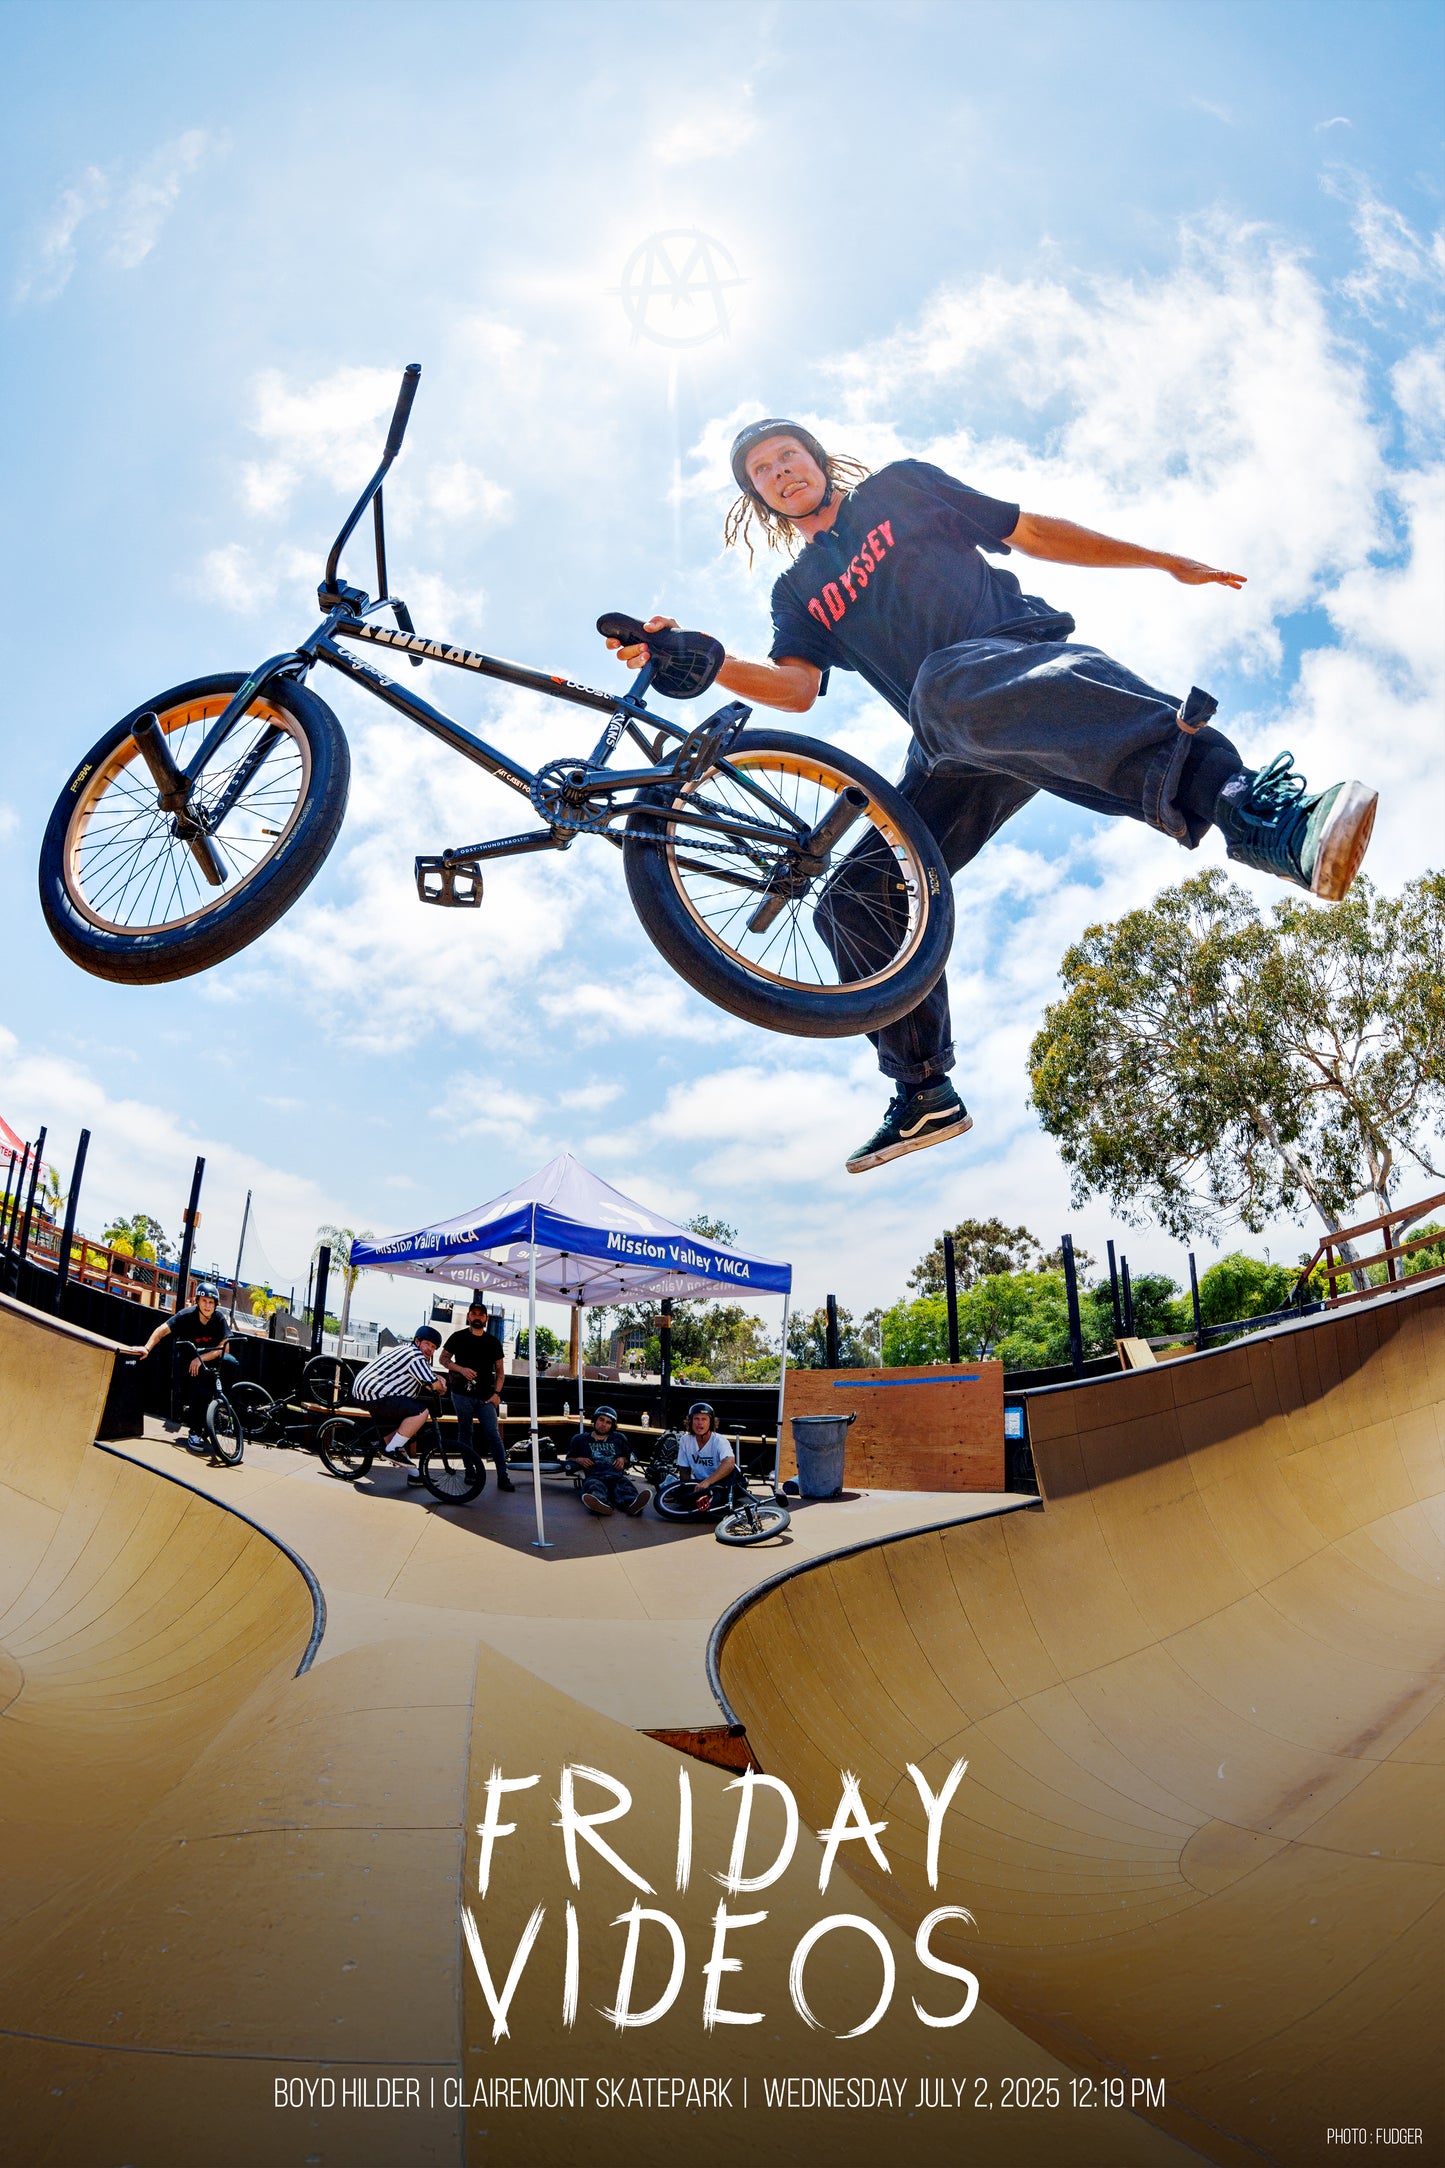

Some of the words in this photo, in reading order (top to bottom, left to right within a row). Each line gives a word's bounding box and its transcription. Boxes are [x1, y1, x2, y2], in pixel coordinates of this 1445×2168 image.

[414, 1233, 442, 1251] Valley
[443, 1229, 480, 1246] YMCA
[606, 1231, 666, 1260] Mission
[668, 1245, 712, 1273] Valley
[714, 1256, 751, 1279] YMCA
